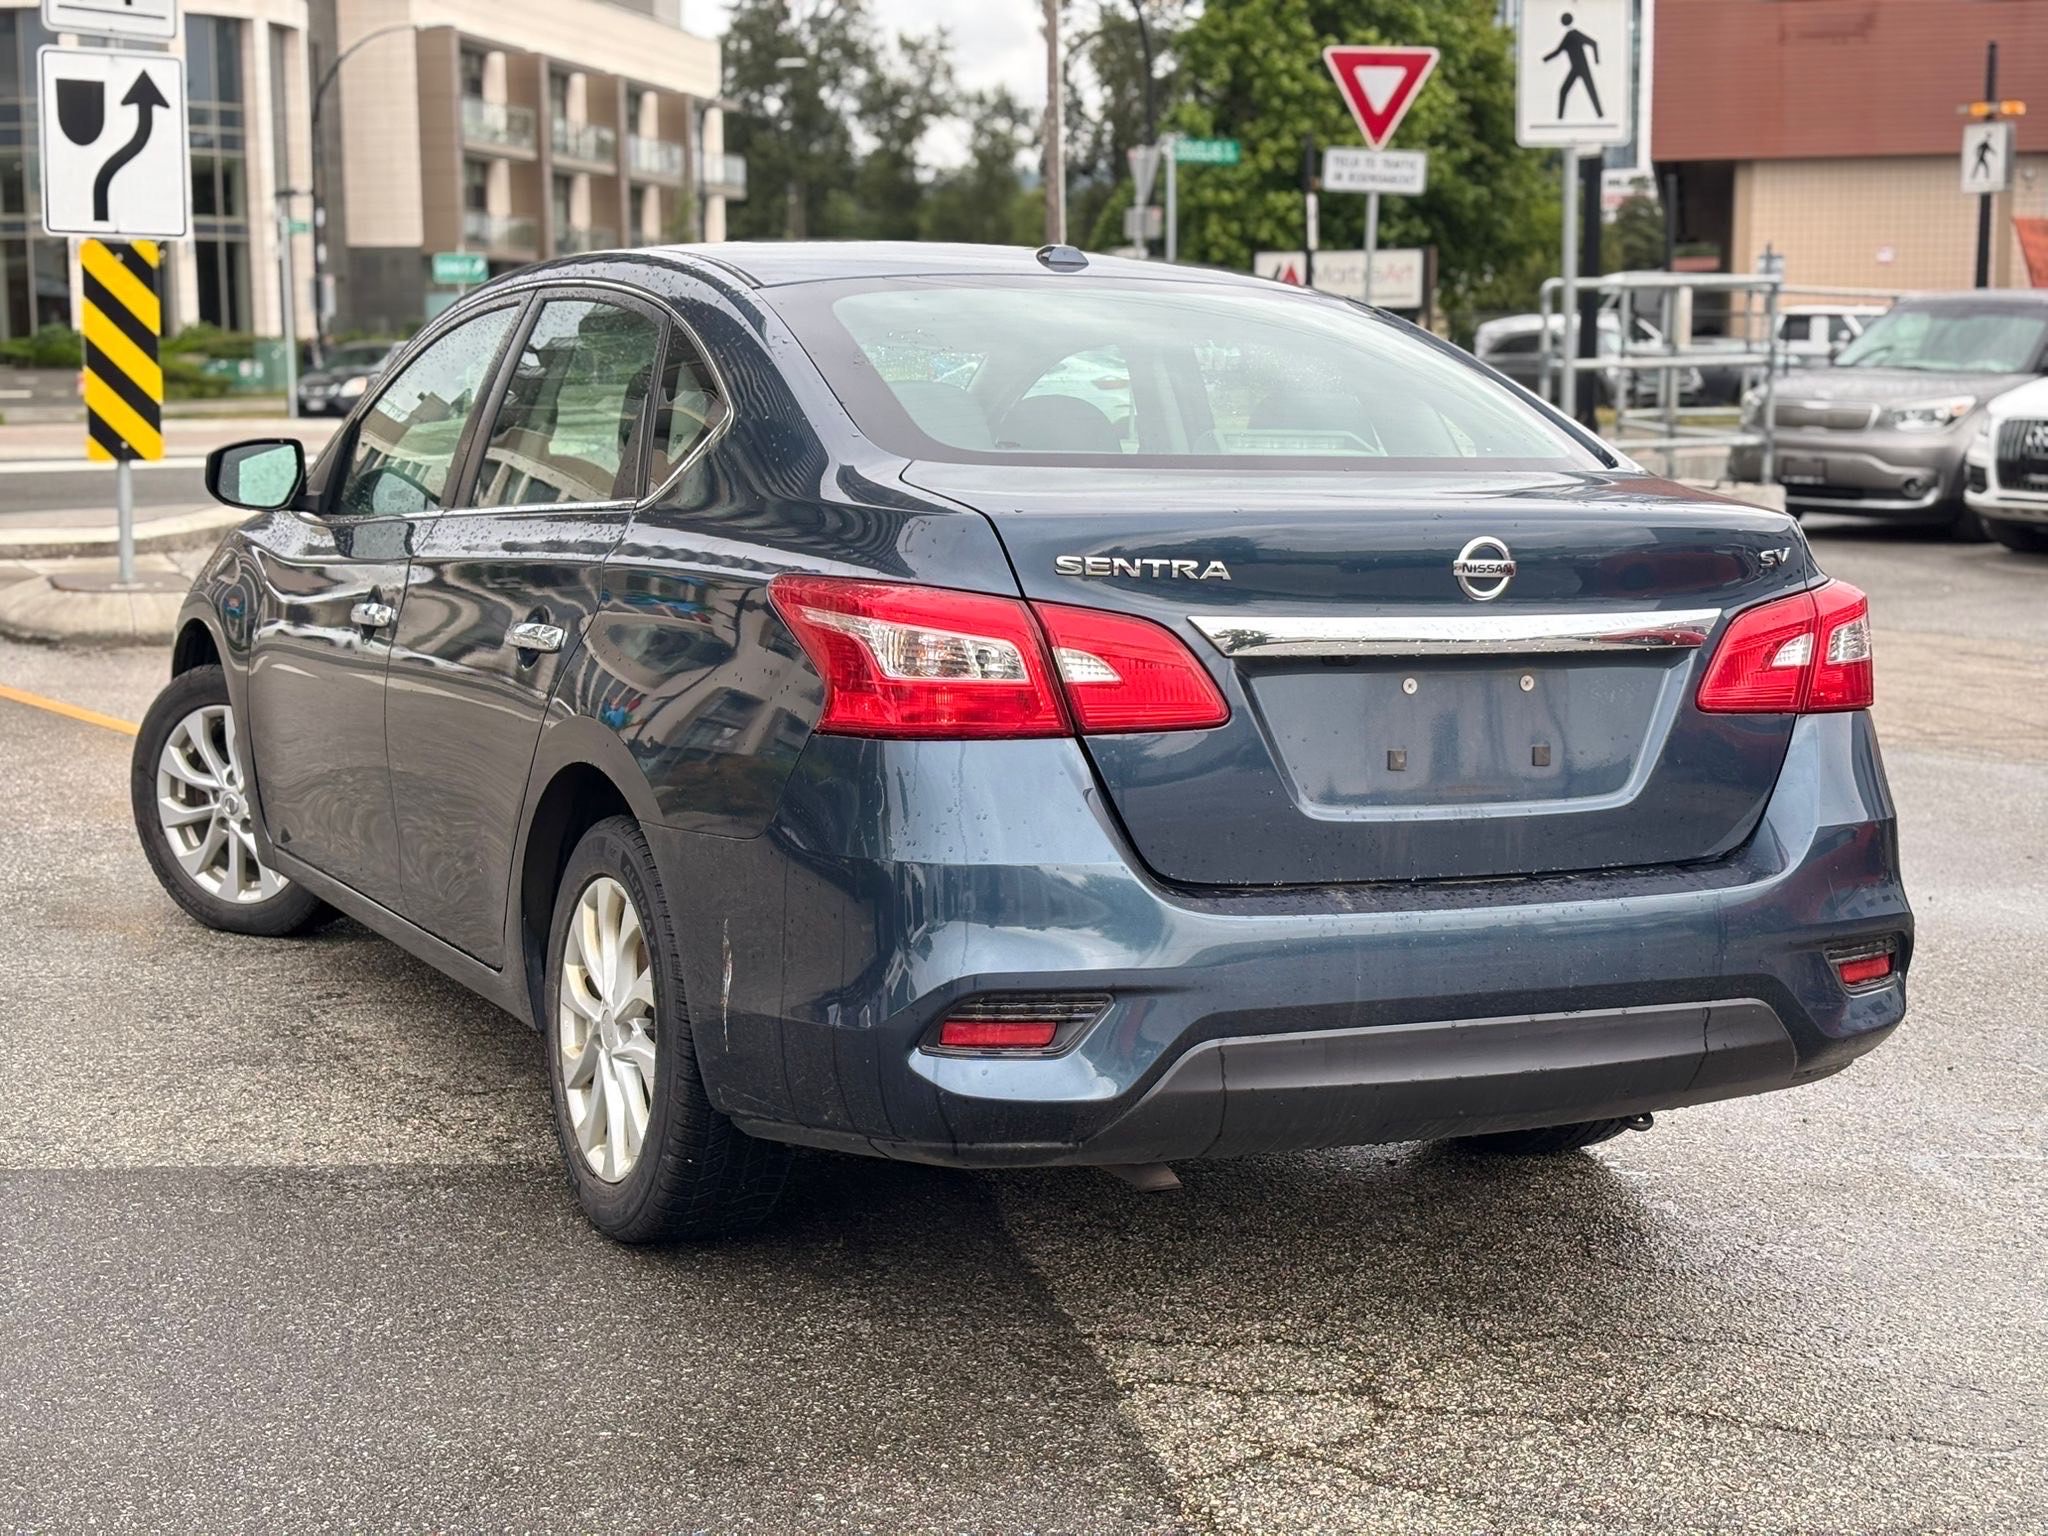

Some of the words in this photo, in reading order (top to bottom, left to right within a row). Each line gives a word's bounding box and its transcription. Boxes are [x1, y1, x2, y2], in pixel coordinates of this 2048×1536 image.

[1055, 555, 1232, 580] SENTRA
[1462, 562, 1512, 574] NISSAN
[1760, 547, 1790, 568] SV
